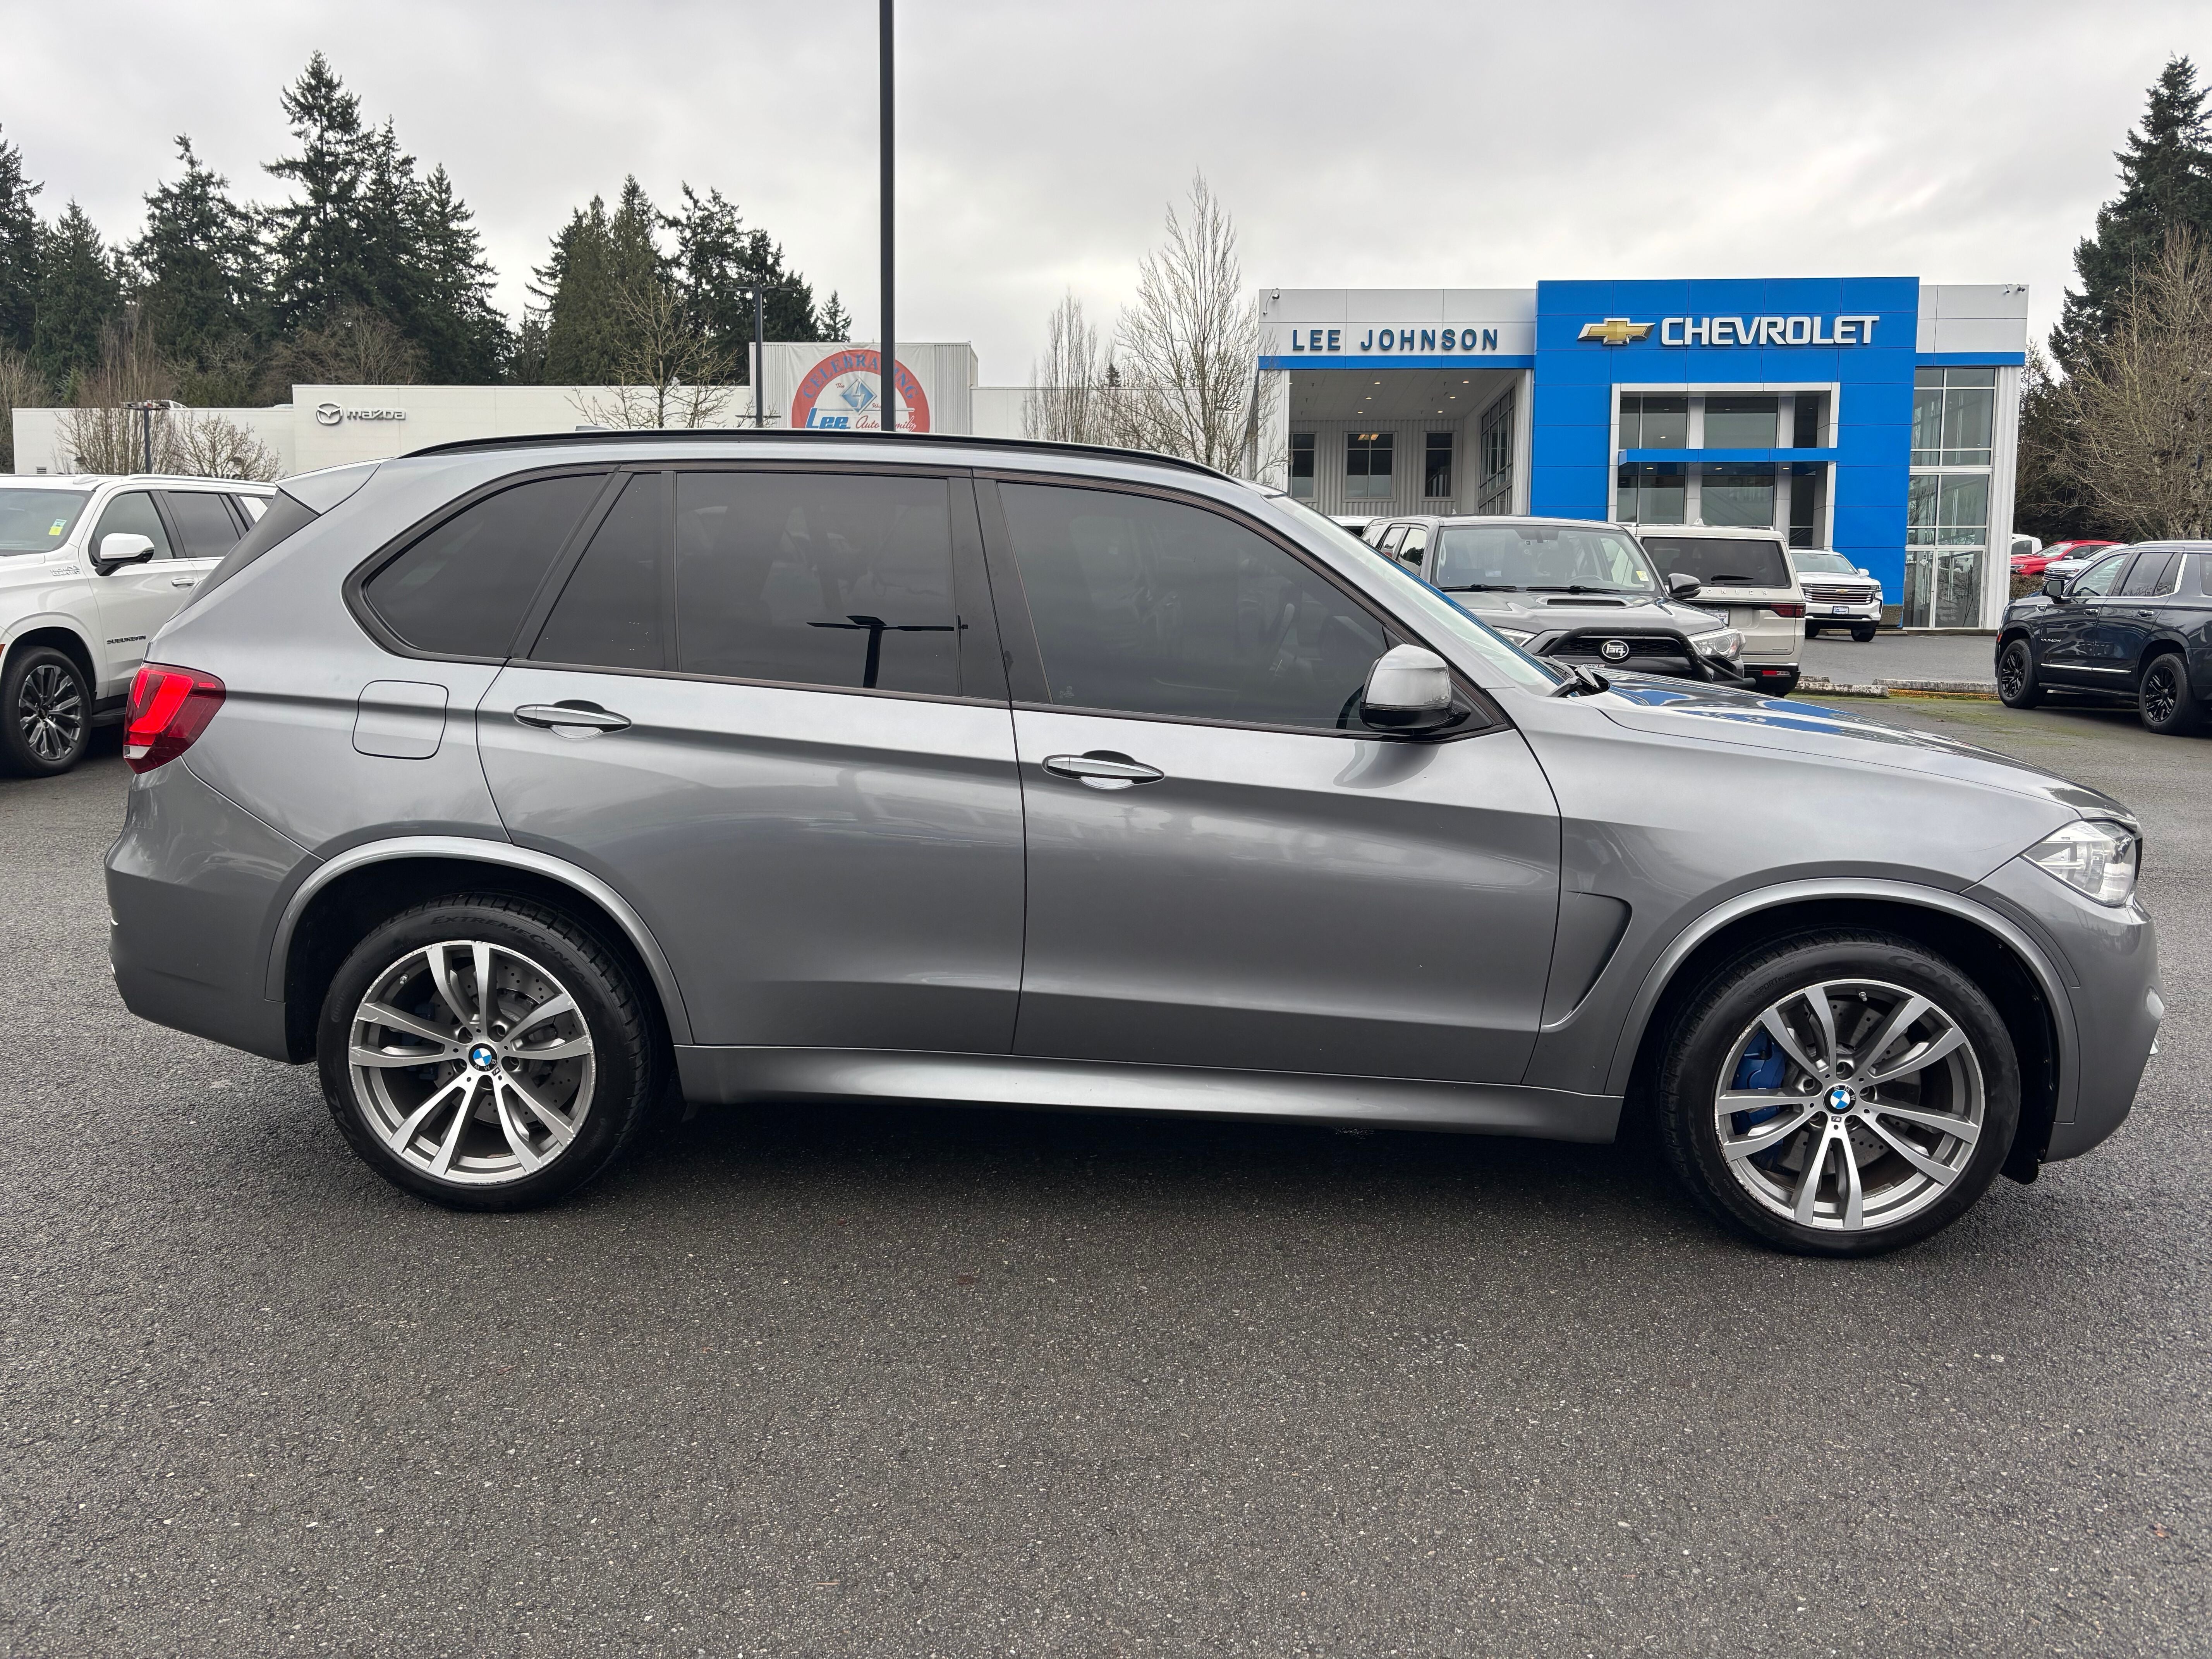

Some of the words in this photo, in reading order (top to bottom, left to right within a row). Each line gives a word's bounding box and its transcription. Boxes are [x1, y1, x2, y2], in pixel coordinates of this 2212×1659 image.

[1293, 330, 1341, 351] LEE
[1360, 329, 1498, 351] JOHNSON
[1661, 316, 1880, 345] CHEVROLET
[803, 354, 919, 398] CELEBRANG
[347, 409, 406, 420] mazda
[805, 407, 851, 429] Lee
[855, 415, 880, 429] Auto
[106, 635, 146, 644] SUBURBAN
[474, 1059, 497, 1071] BMW
[1833, 1085, 1856, 1101] BMW
